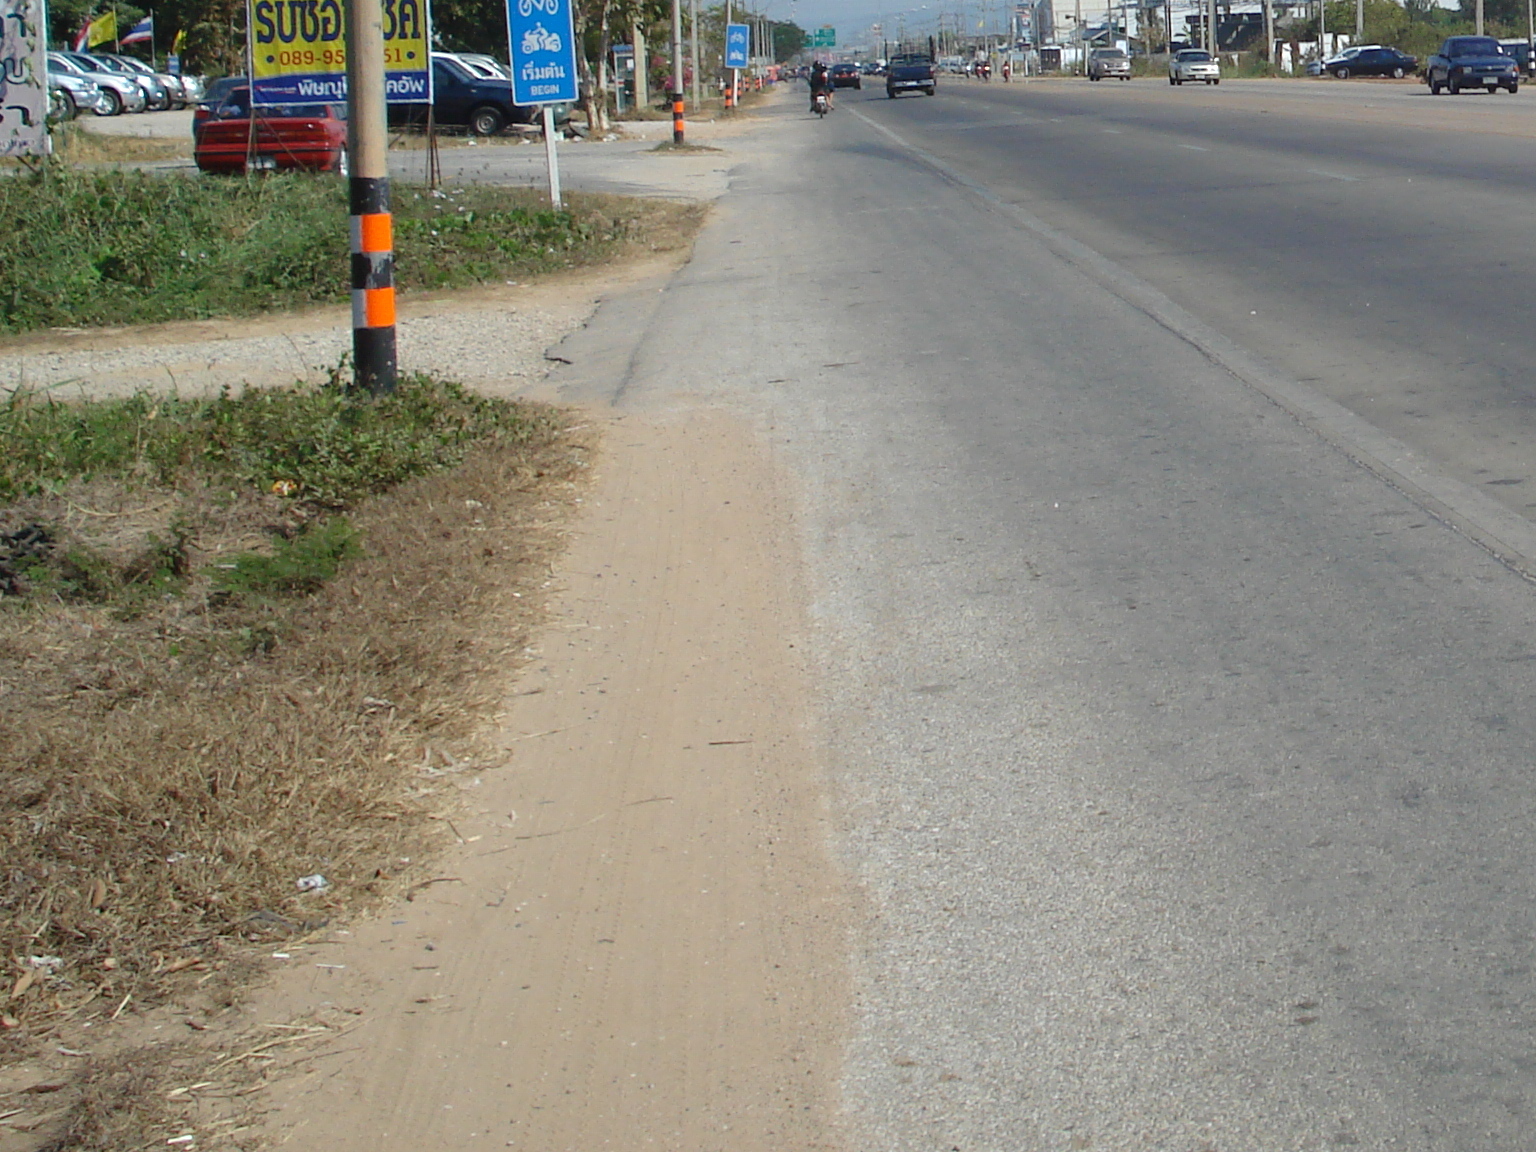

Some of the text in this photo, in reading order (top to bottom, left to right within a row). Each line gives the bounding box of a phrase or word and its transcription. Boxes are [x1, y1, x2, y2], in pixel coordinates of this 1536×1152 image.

[522, 60, 566, 81] เริ่มต้น
[530, 84, 560, 96] BEGIN
